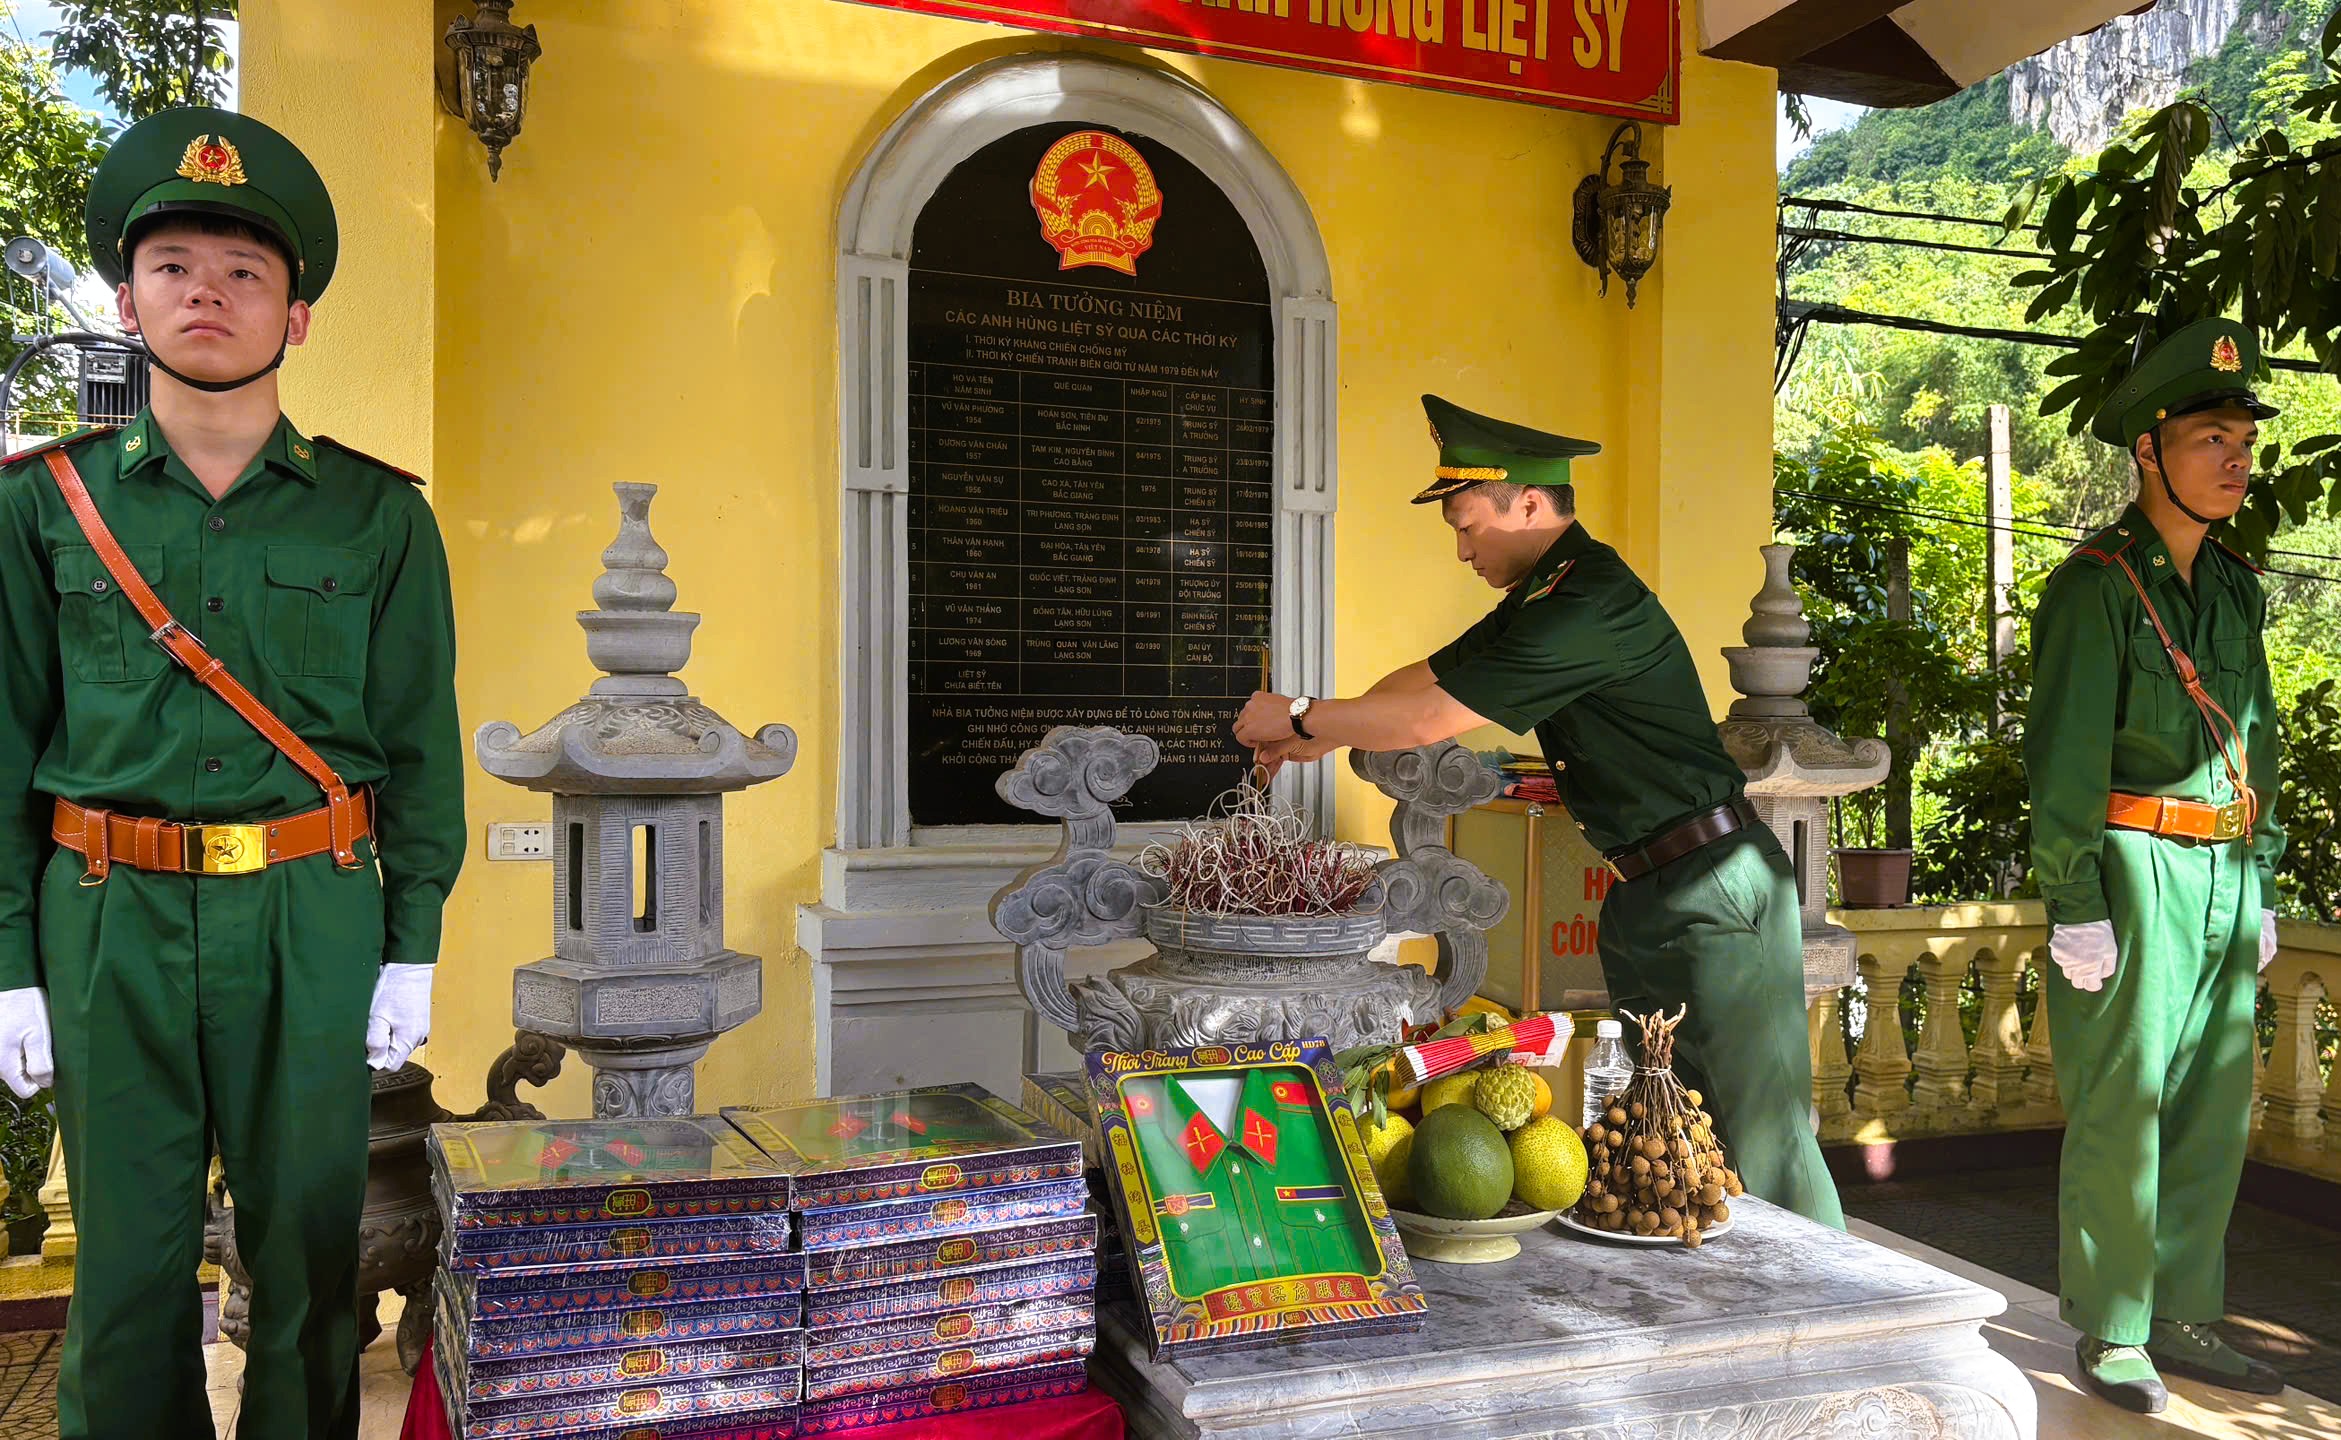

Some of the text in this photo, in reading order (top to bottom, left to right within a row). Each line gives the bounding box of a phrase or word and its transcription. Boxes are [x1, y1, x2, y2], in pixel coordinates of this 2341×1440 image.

[1006, 289, 1184, 324] BIA TƯỞNG NIỆM
[944, 308, 1238, 349] CÁC ANH HÙNG LIỆT SỸ QUA CÁC THỜI KỲ
[1053, 457, 1070, 467] CAO
[965, 616, 982, 625] 1974
[1135, 641, 1161, 651] 02/1990
[932, 706, 953, 718] NHÀ
[955, 708, 972, 718] BIA
[974, 705, 1009, 719] TƯỞNG
[1010, 707, 1035, 721] NIỆM
[1036, 707, 1064, 721] ĐƯỢC
[1065, 706, 1084, 719] XÂY
[1086, 708, 1113, 722] DỰNG
[1115, 704, 1128, 719] ĐỂ
[1130, 706, 1143, 719] TỎ
[1144, 707, 1169, 720] LÒNG
[1171, 707, 1190, 720] TÔN
[1192, 707, 1216, 721] KÍNH,
[1218, 710, 1231, 719] TRI
[967, 724, 984, 734] GHI
[986, 722, 1008, 734] NHỚ
[1010, 722, 1038, 734] CÔNG
[1136, 724, 1155, 734] ANH
[1157, 722, 1183, 734] HÙNG
[1185, 722, 1204, 736] LIỆT
[1205, 722, 1217, 734] SỸ
[962, 737, 992, 749] CHIẾN
[994, 736, 1016, 750] ĐẤU,
[1018, 739, 1032, 749] HY
[1166, 737, 1186, 750] CÁC
[1188, 738, 1209, 749] THỜI
[1210, 738, 1225, 750] KỲ.
[942, 752, 966, 765] KHỞI
[968, 752, 997, 765] CÔNG
[1159, 753, 1240, 765] HÁNG 11 NĂM 2018
[1101, 1051, 1140, 1074] Thời
[1141, 1050, 1188, 1070] Trang
[1234, 1046, 1265, 1063] Cao
[1269, 1040, 1300, 1063] Cấp
